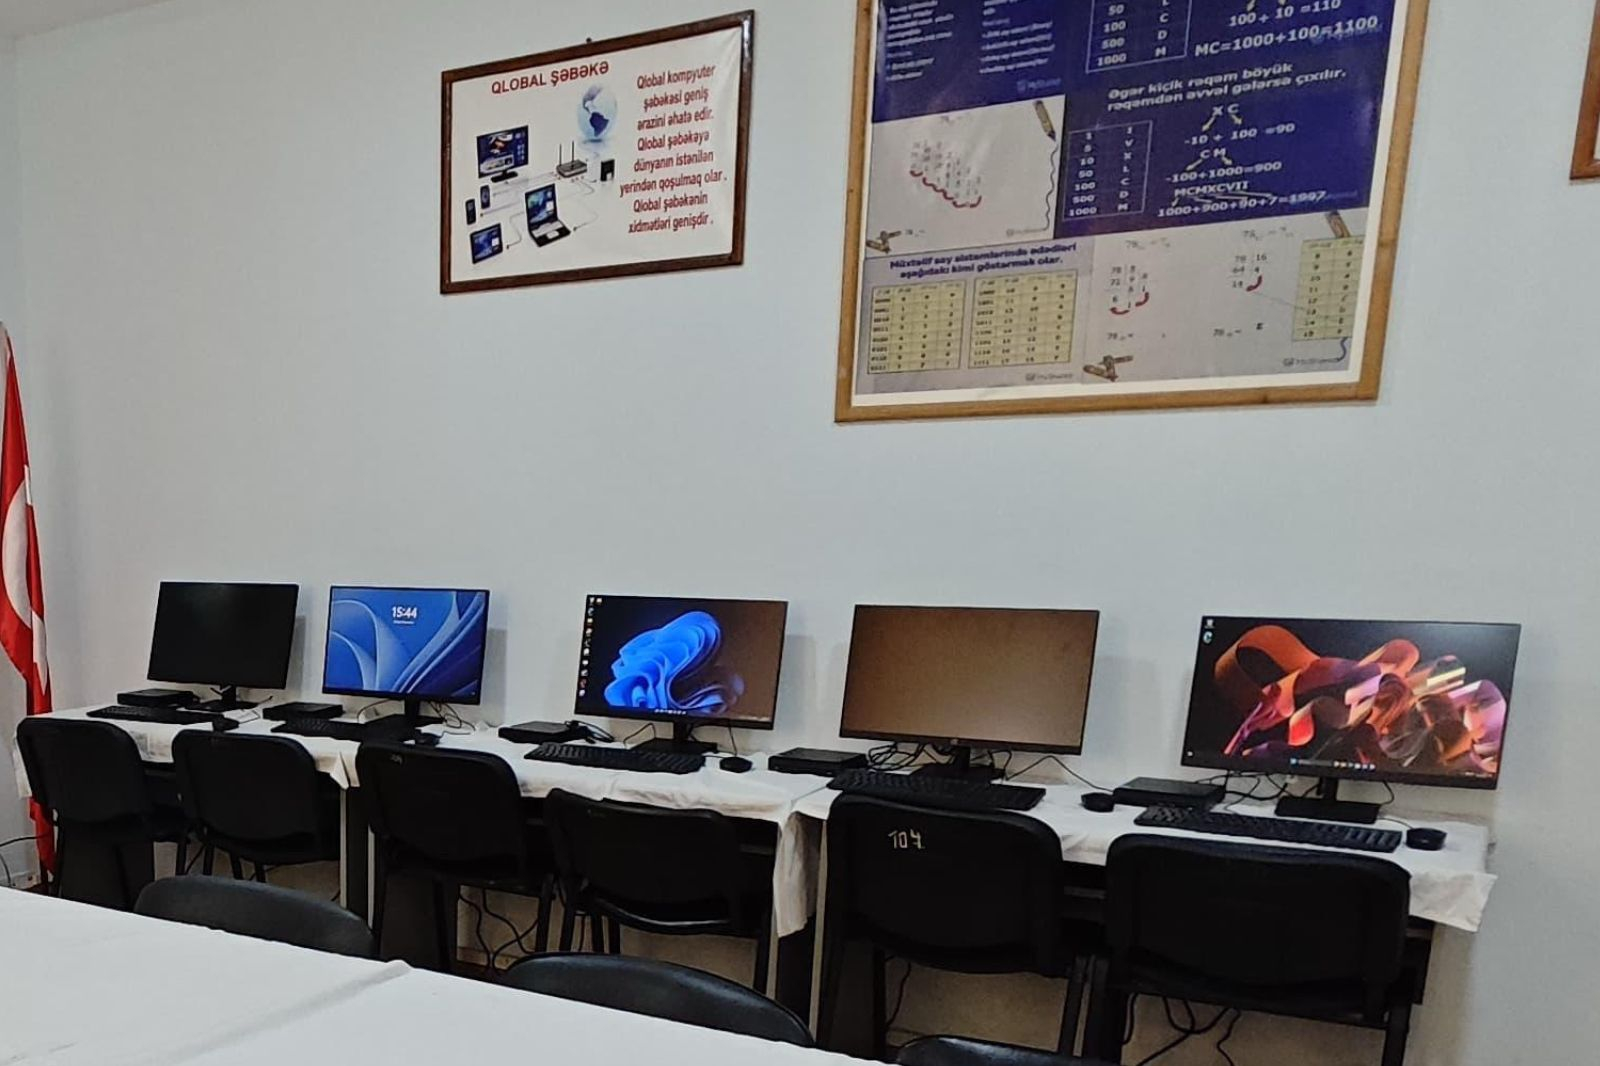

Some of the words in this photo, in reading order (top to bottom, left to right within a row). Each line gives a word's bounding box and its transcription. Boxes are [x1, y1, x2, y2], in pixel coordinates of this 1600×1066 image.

[1108, 4, 1125, 16] 50
[1229, 12, 1256, 27] 100
[1275, 6, 1294, 19] 10
[1160, 13, 1169, 23] C
[1103, 21, 1126, 33] 100
[1157, 30, 1167, 40] D
[1194, 15, 1378, 57] MC=1000+100=1100
[1101, 37, 1125, 49] 500
[1155, 46, 1167, 57] M
[1097, 53, 1127, 66] 1000
[491, 73, 547, 94] QLOBAL
[550, 61, 609, 86] ŞƏBƏKƏ
[637, 72, 666, 89] Qlobal
[667, 65, 716, 84] kompyuter
[1149, 79, 1183, 95] kiçik
[1242, 62, 1293, 80] böyük
[684, 85, 709, 105] geniş
[1212, 105, 1224, 116] X
[1227, 103, 1240, 114] C
[1231, 128, 1258, 140] 100
[1265, 123, 1295, 135] =90
[637, 134, 666, 151] Qlobal
[1125, 139, 1134, 147] V
[1200, 149, 1210, 159] C
[1213, 148, 1226, 157] M
[1080, 157, 1094, 166] 10
[659, 173, 702, 192] qoşulmaq
[1120, 177, 1130, 185] C
[1119, 190, 1129, 199] D
[1174, 181, 1249, 198] MCMXCVII
[634, 197, 661, 213] Qlobal
[1069, 207, 1097, 216] 1000
[392, 606, 417, 619] 15:44
[888, 829, 924, 850] 104
